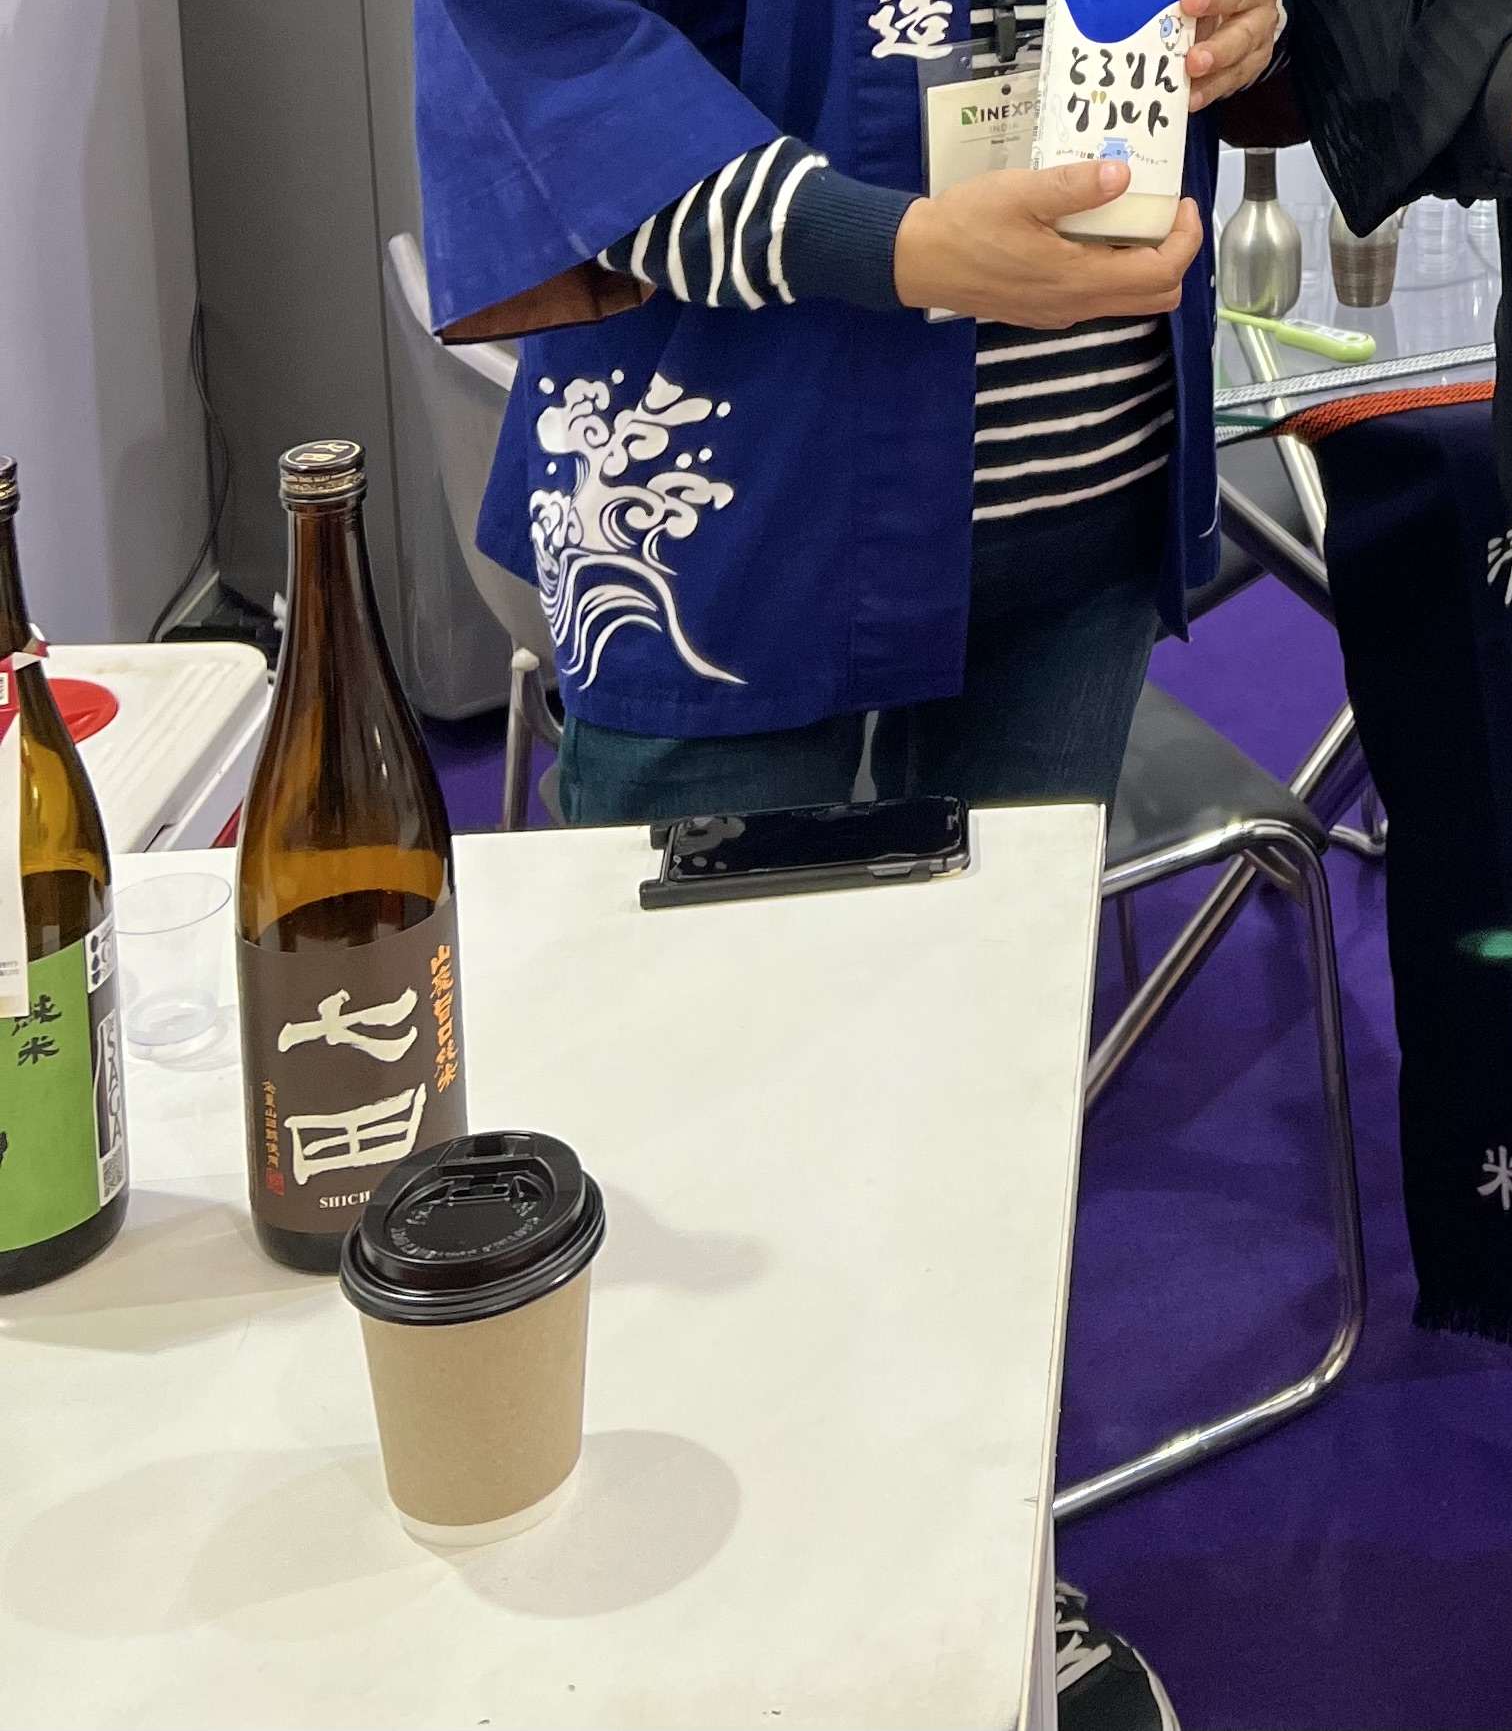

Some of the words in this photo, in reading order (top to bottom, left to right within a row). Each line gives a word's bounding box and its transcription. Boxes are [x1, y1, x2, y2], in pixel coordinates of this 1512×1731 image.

[1071, 46, 1178, 93] とろりん
[962, 100, 1036, 125] VINEXP
[277, 986, 427, 1185] 七田
[319, 1190, 371, 1210] SHICH
